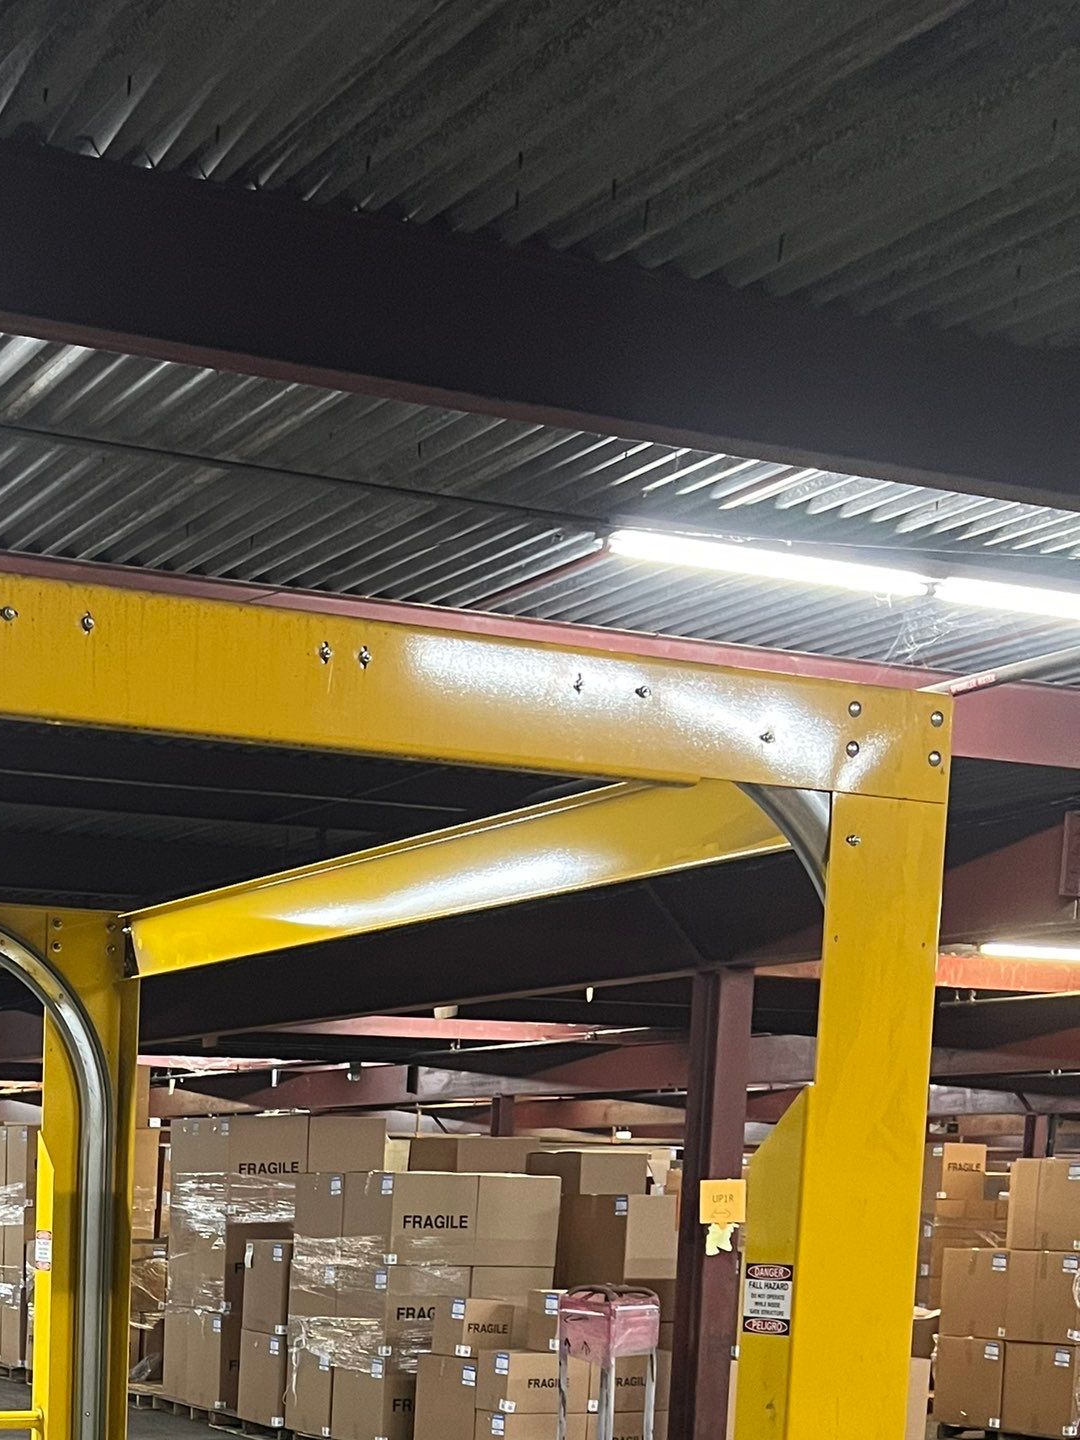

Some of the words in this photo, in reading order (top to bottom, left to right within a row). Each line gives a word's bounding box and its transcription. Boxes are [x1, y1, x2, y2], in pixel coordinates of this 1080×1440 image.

[238, 1161, 299, 1175] FRAGILE
[947, 1162, 981, 1172] FRAGILE
[402, 1214, 469, 1229] FRAGILE
[754, 1267, 784, 1278] DANGER
[748, 1281, 763, 1290] FALL
[764, 1282, 789, 1291] HAZARD
[396, 1307, 436, 1321] FRAG
[467, 1322, 509, 1334] FRAGILE
[751, 1319, 783, 1332] PELIGRO
[527, 1378, 570, 1389] FRAGIL
[615, 1376, 646, 1387] RAGIL
